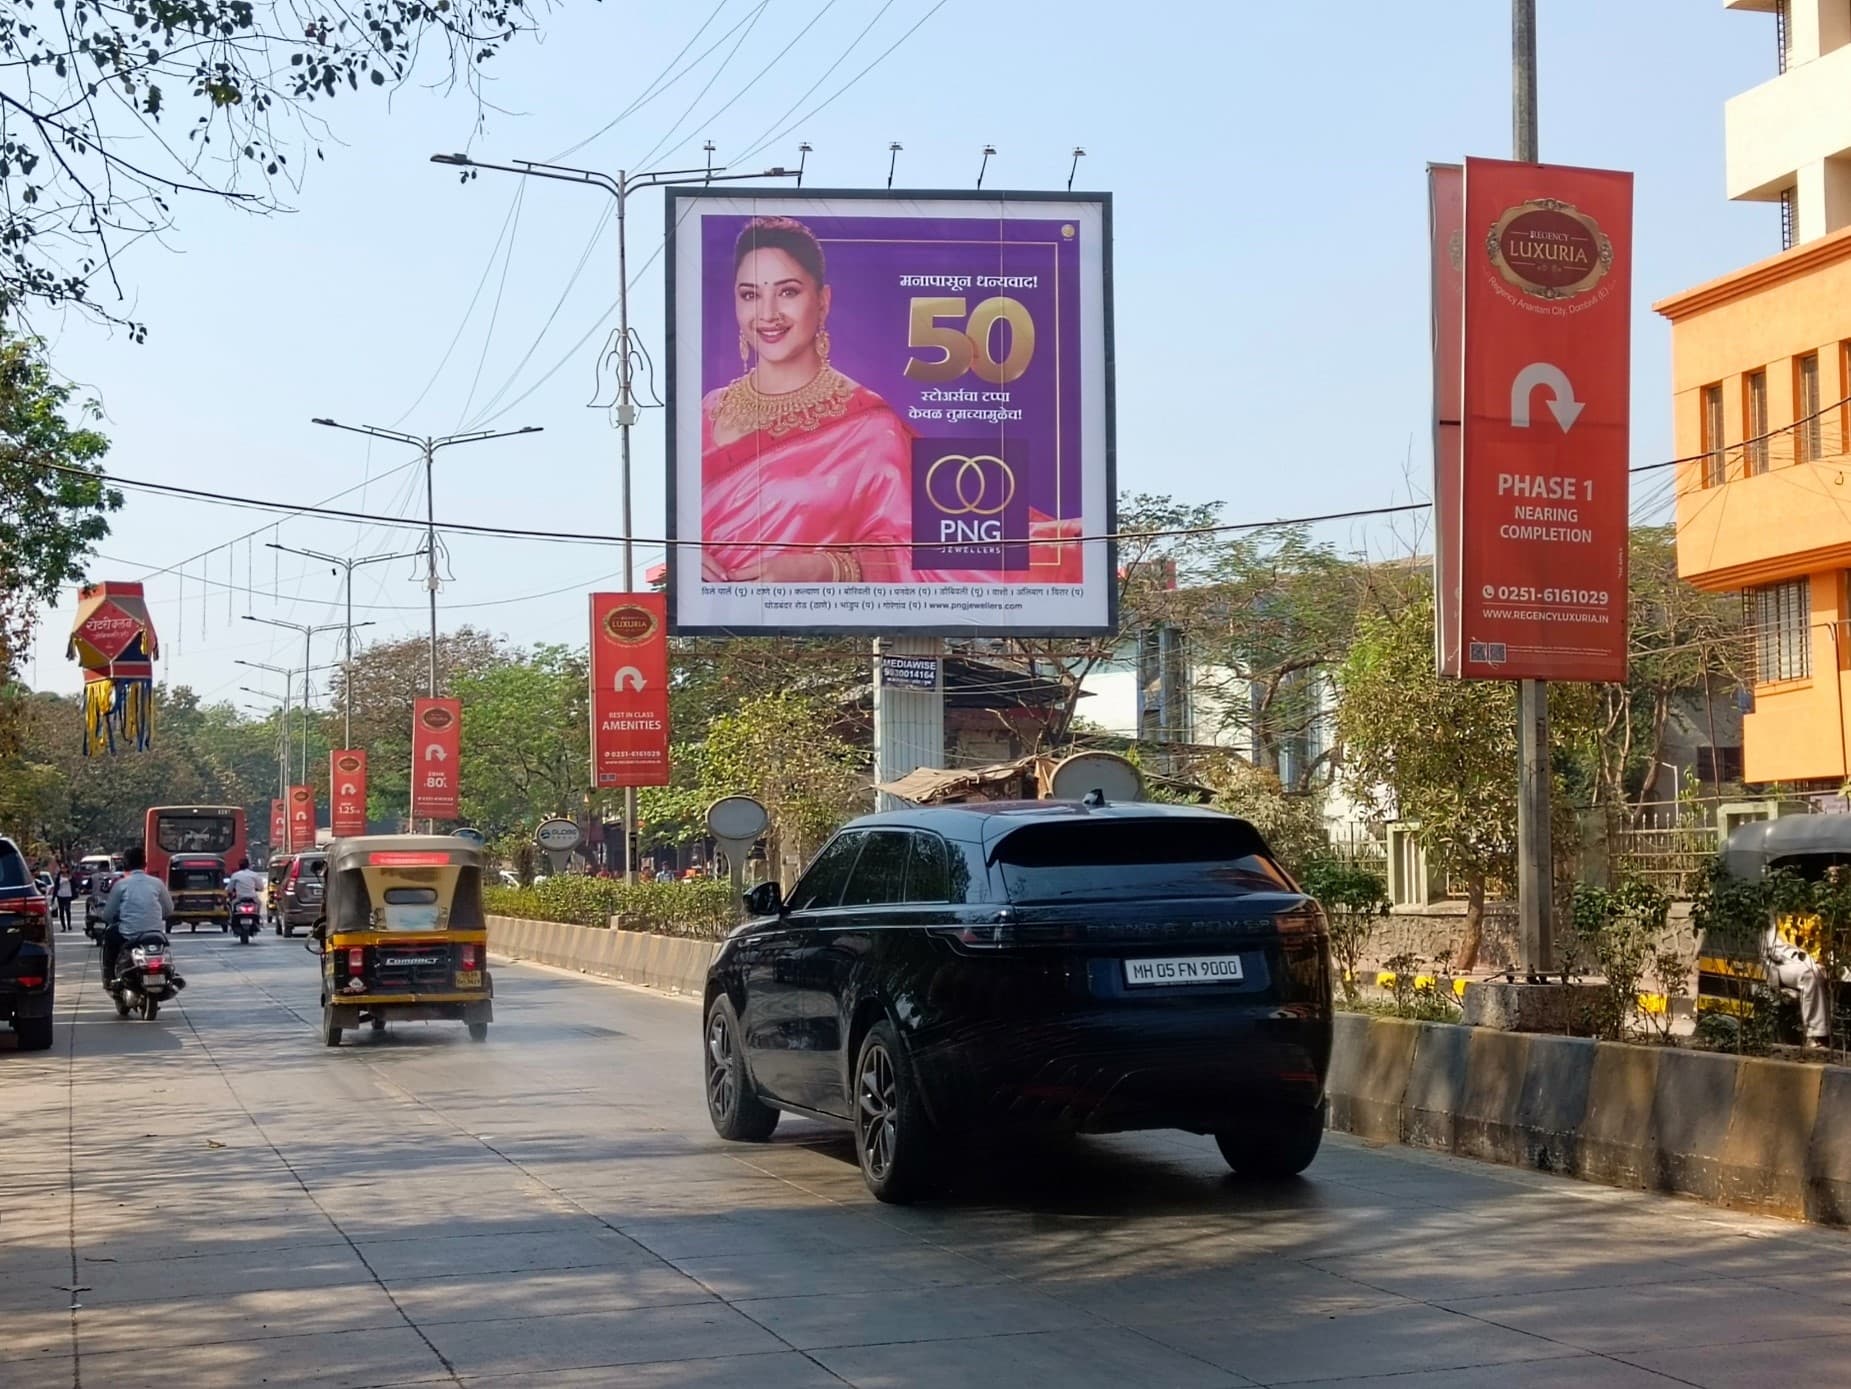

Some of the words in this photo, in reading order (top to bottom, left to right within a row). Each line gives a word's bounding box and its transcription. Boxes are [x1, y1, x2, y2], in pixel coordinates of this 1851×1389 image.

[1530, 231, 1569, 242] REGENCY
[1510, 240, 1588, 263] LUXURIA
[900, 275, 971, 291] मनापासून
[976, 276, 1038, 288] धन्यवाद!
[904, 296, 1035, 384] 50
[908, 406, 942, 419] केवळ
[1498, 474, 1576, 500] PHASE
[1584, 480, 1593, 501] 1
[1515, 506, 1578, 522] NEARING
[941, 519, 1001, 542] PNG
[1500, 525, 1592, 543] COMPLETION
[941, 546, 1001, 554] JEWELLERS
[1498, 586, 1609, 605] 0251-6161029
[1483, 609, 1609, 623] WWW.REGENCYLUXURIA.IN
[602, 720, 662, 730] AMENITIES
[1133, 964, 1154, 979] MH
[1156, 963, 1175, 978] 05
[1178, 962, 1198, 977] FN
[1201, 960, 1237, 976] 9000
